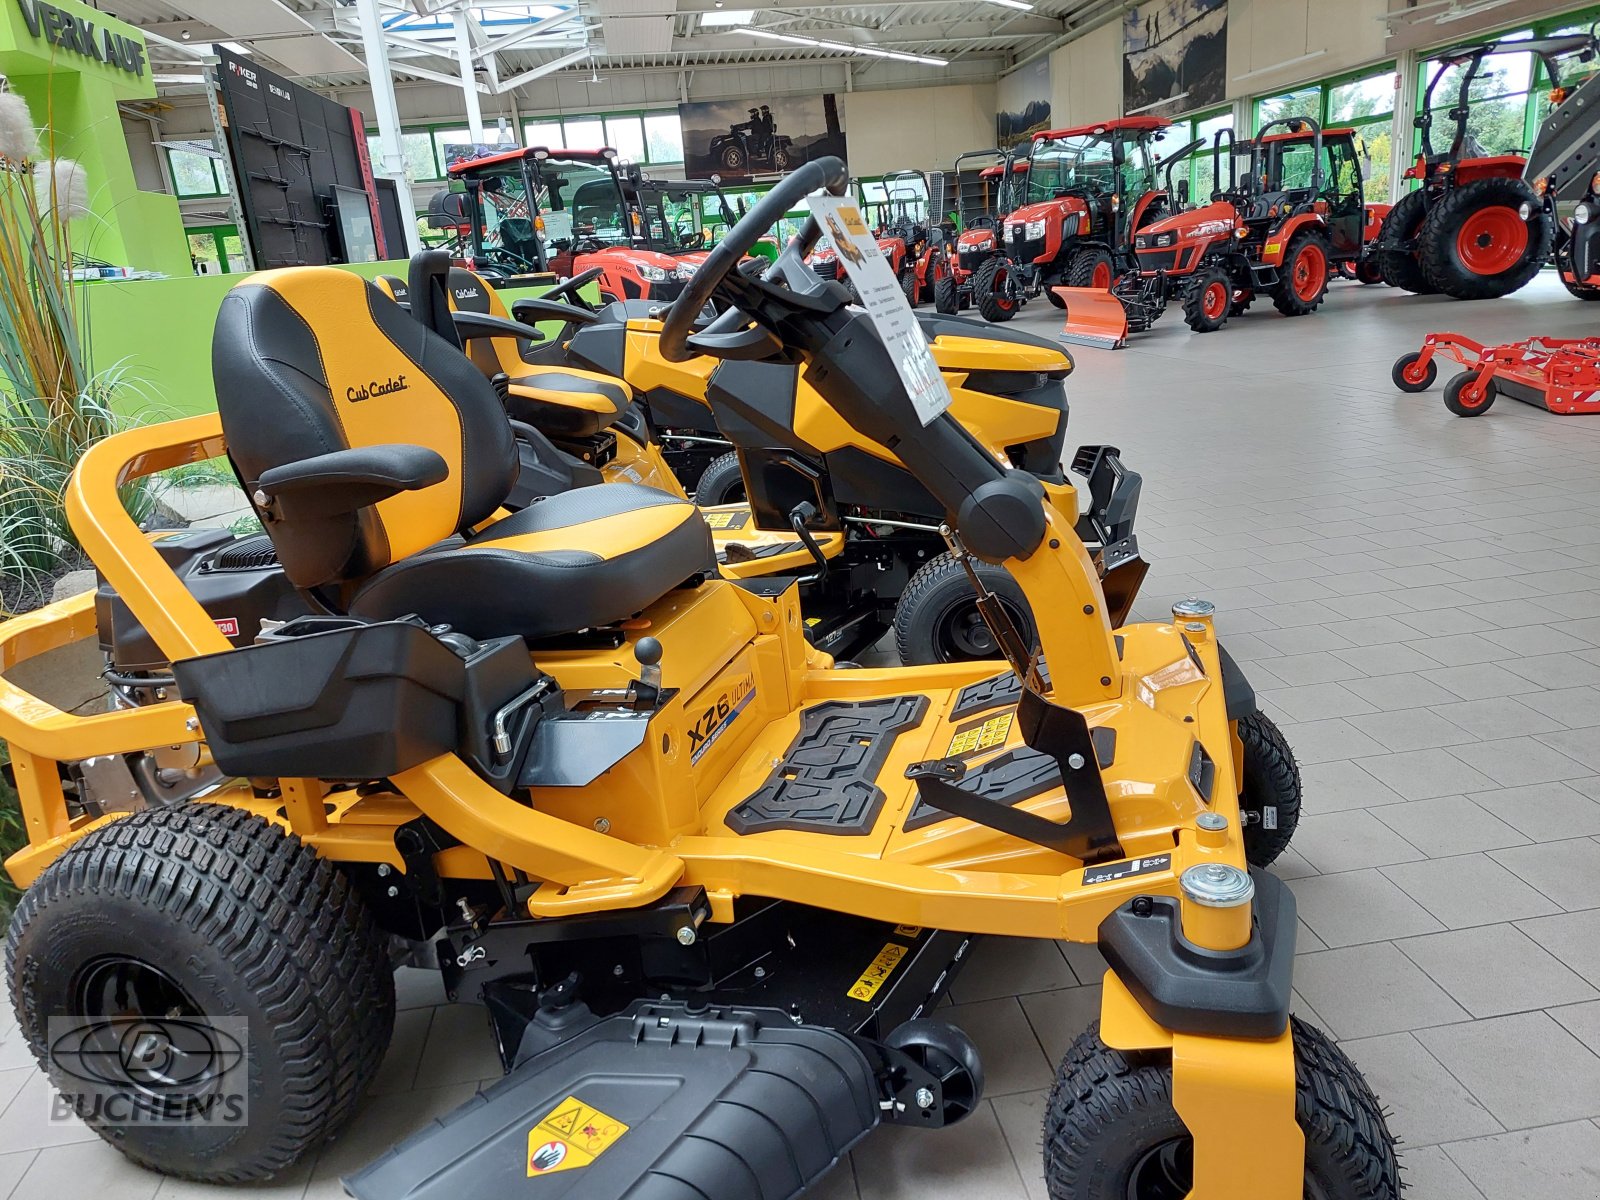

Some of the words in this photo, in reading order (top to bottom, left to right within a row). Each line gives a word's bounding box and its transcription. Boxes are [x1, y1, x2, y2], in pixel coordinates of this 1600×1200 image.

[17, 0, 146, 76] VERKAUF
[229, 61, 257, 82] RYKER
[687, 693, 730, 754] XZ6
[731, 671, 755, 706] ULTIMA
